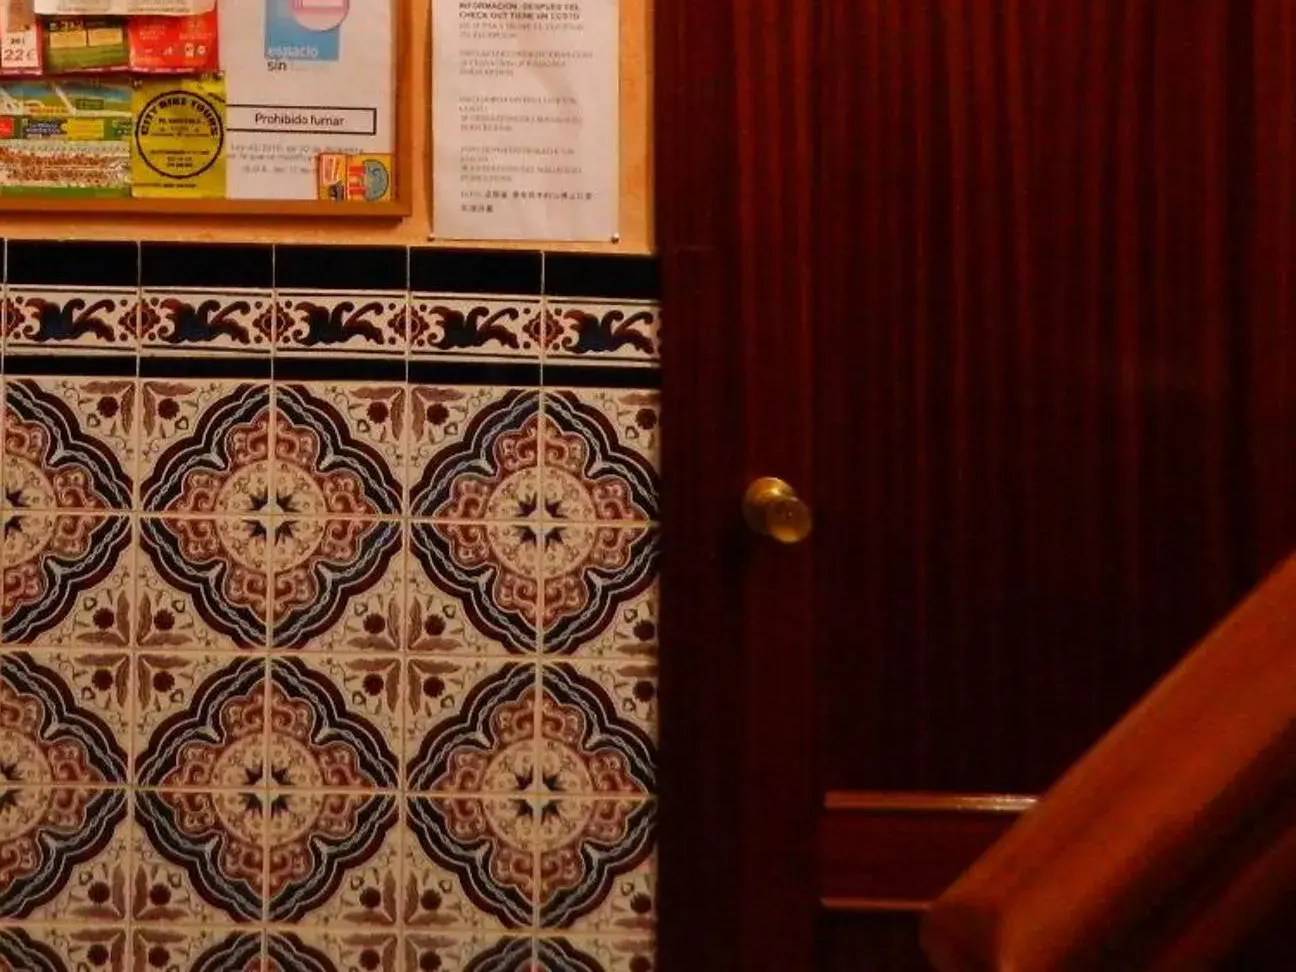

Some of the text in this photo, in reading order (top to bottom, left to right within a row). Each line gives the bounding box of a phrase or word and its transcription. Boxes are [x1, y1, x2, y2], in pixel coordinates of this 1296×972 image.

[267, 59, 288, 71] sin
[255, 112, 346, 127] Prohibido fumar
